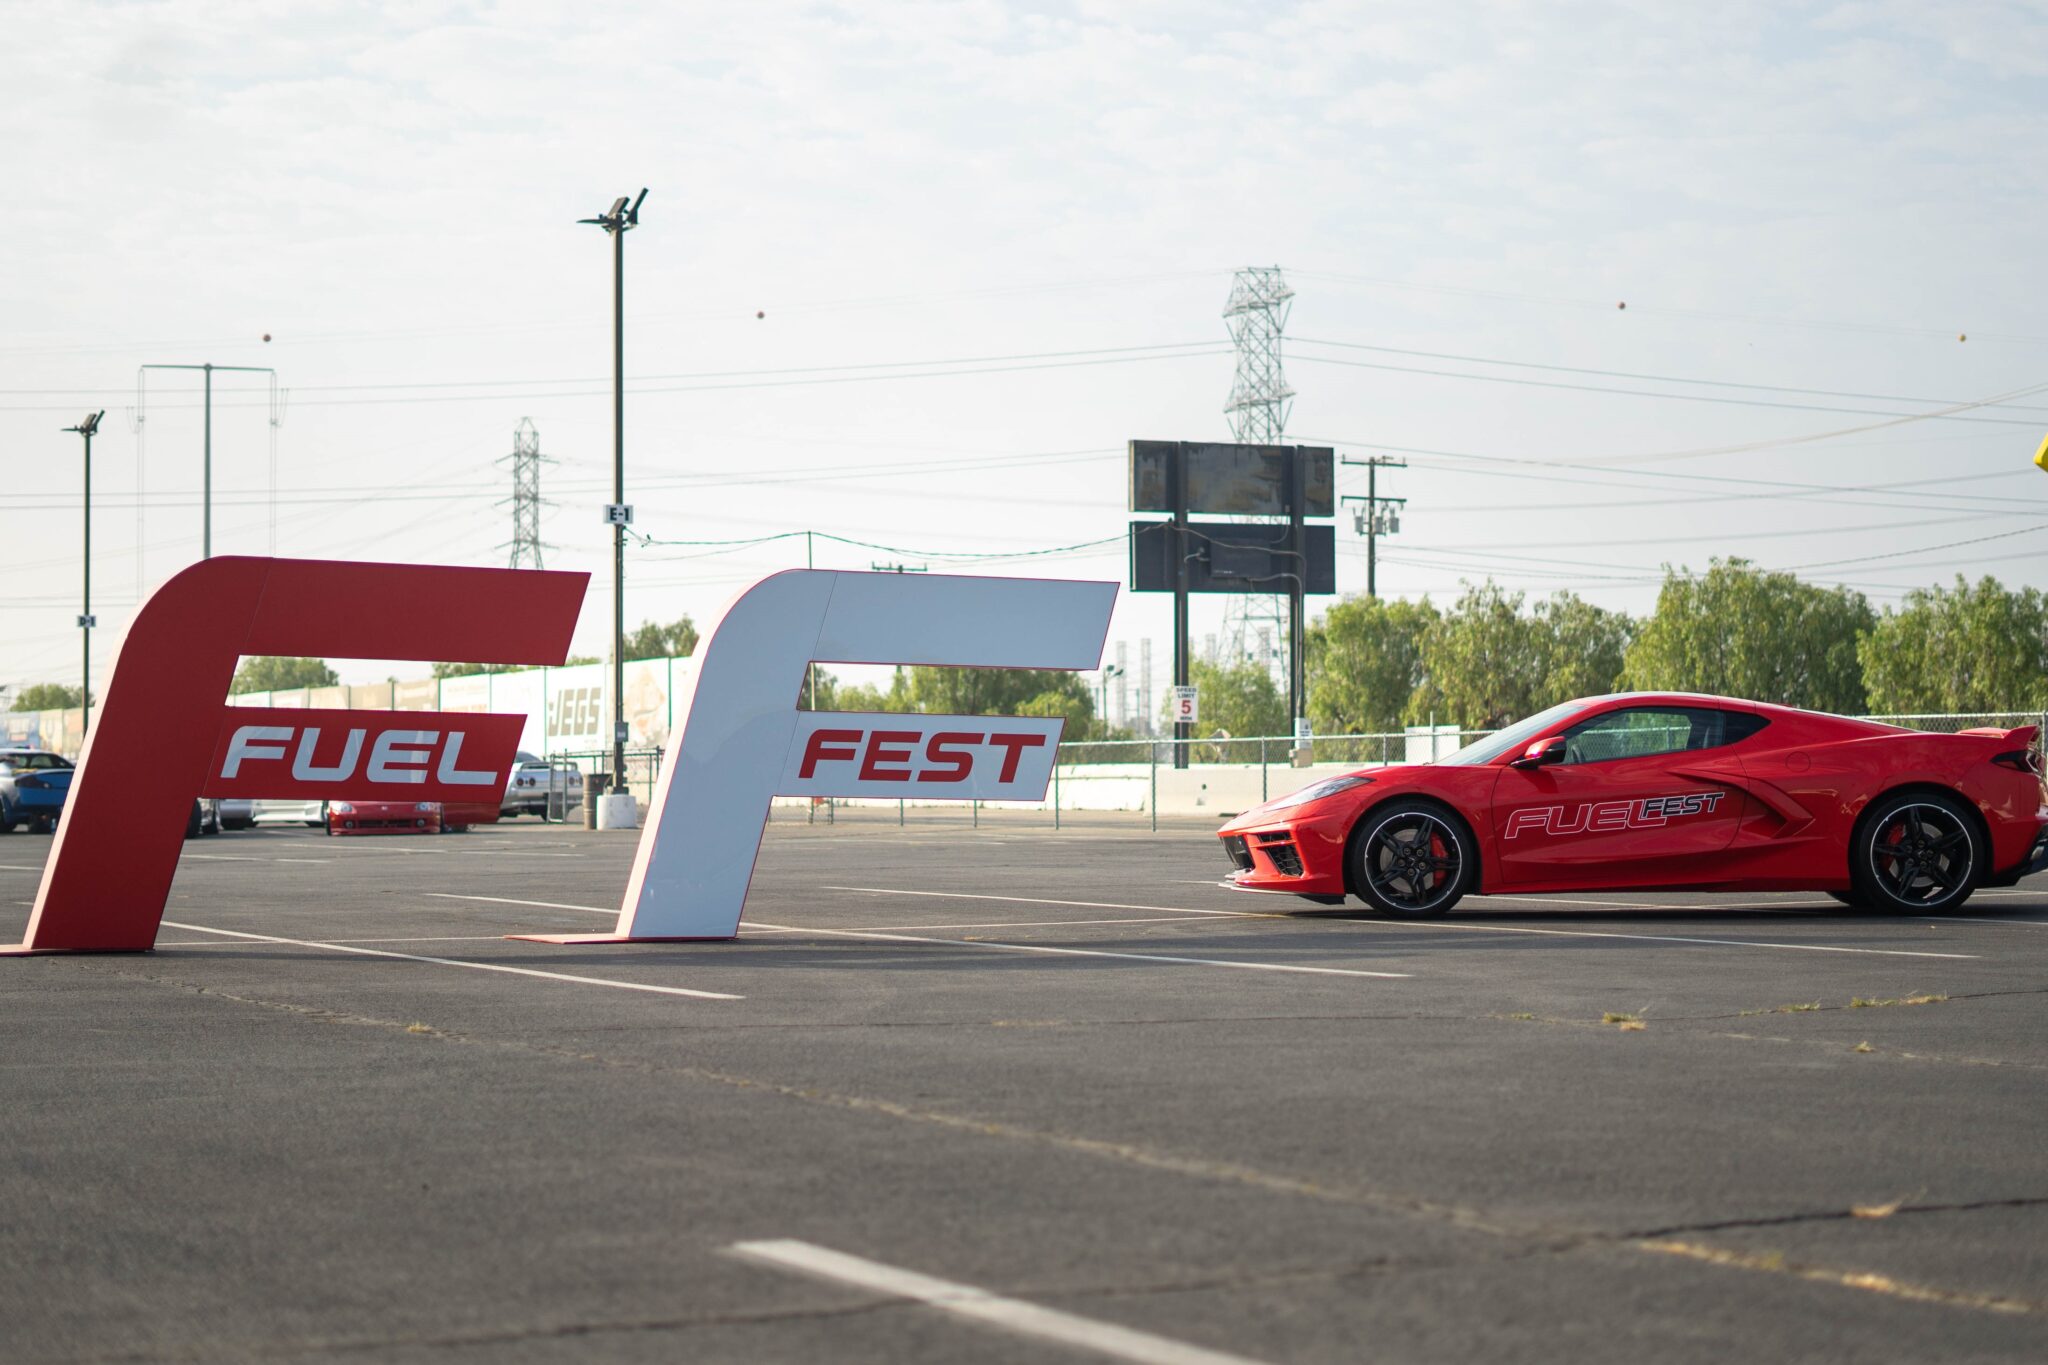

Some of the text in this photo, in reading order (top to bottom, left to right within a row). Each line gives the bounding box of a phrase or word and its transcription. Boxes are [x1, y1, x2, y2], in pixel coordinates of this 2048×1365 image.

[610, 507, 629, 521] E-1
[548, 687, 601, 736] JEGS
[1181, 700, 1191, 714] 5
[220, 725, 498, 785] FUEL
[798, 729, 1046, 783] FEST
